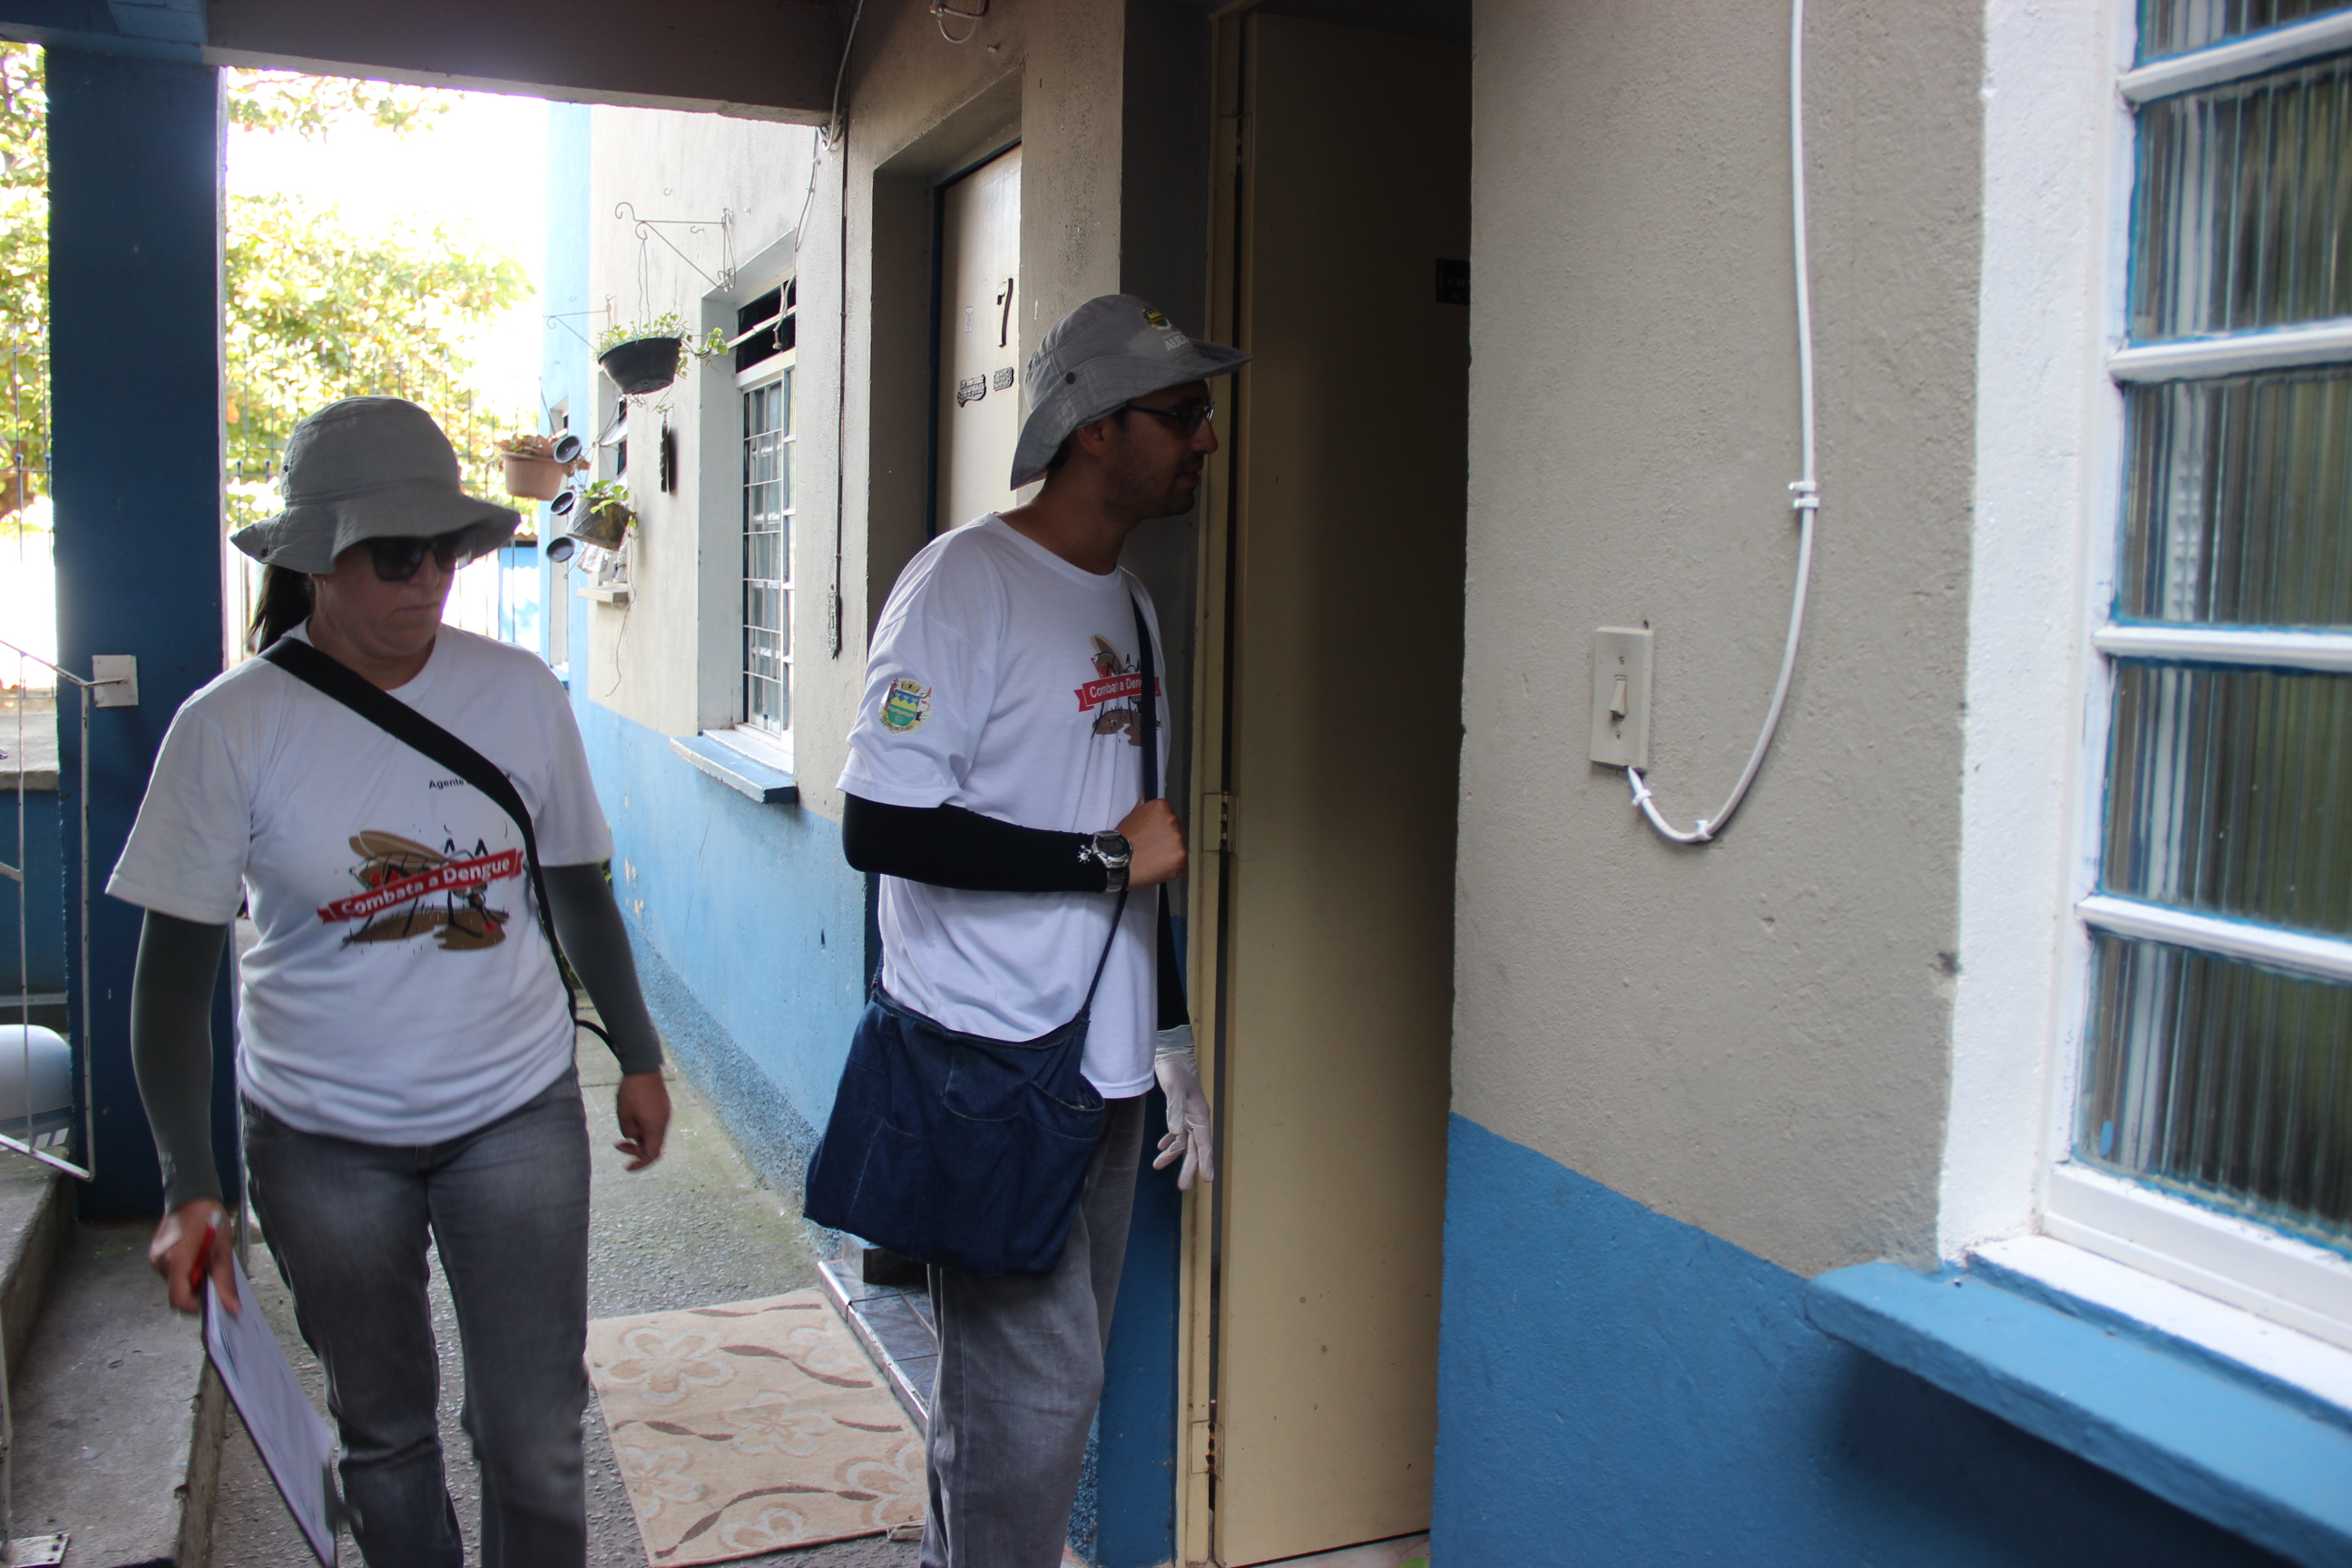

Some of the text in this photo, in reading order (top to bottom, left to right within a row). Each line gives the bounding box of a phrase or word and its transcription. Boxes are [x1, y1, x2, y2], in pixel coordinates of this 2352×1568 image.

[429, 779, 465, 789] Agente
[341, 858, 510, 915] Combata a Dengue
